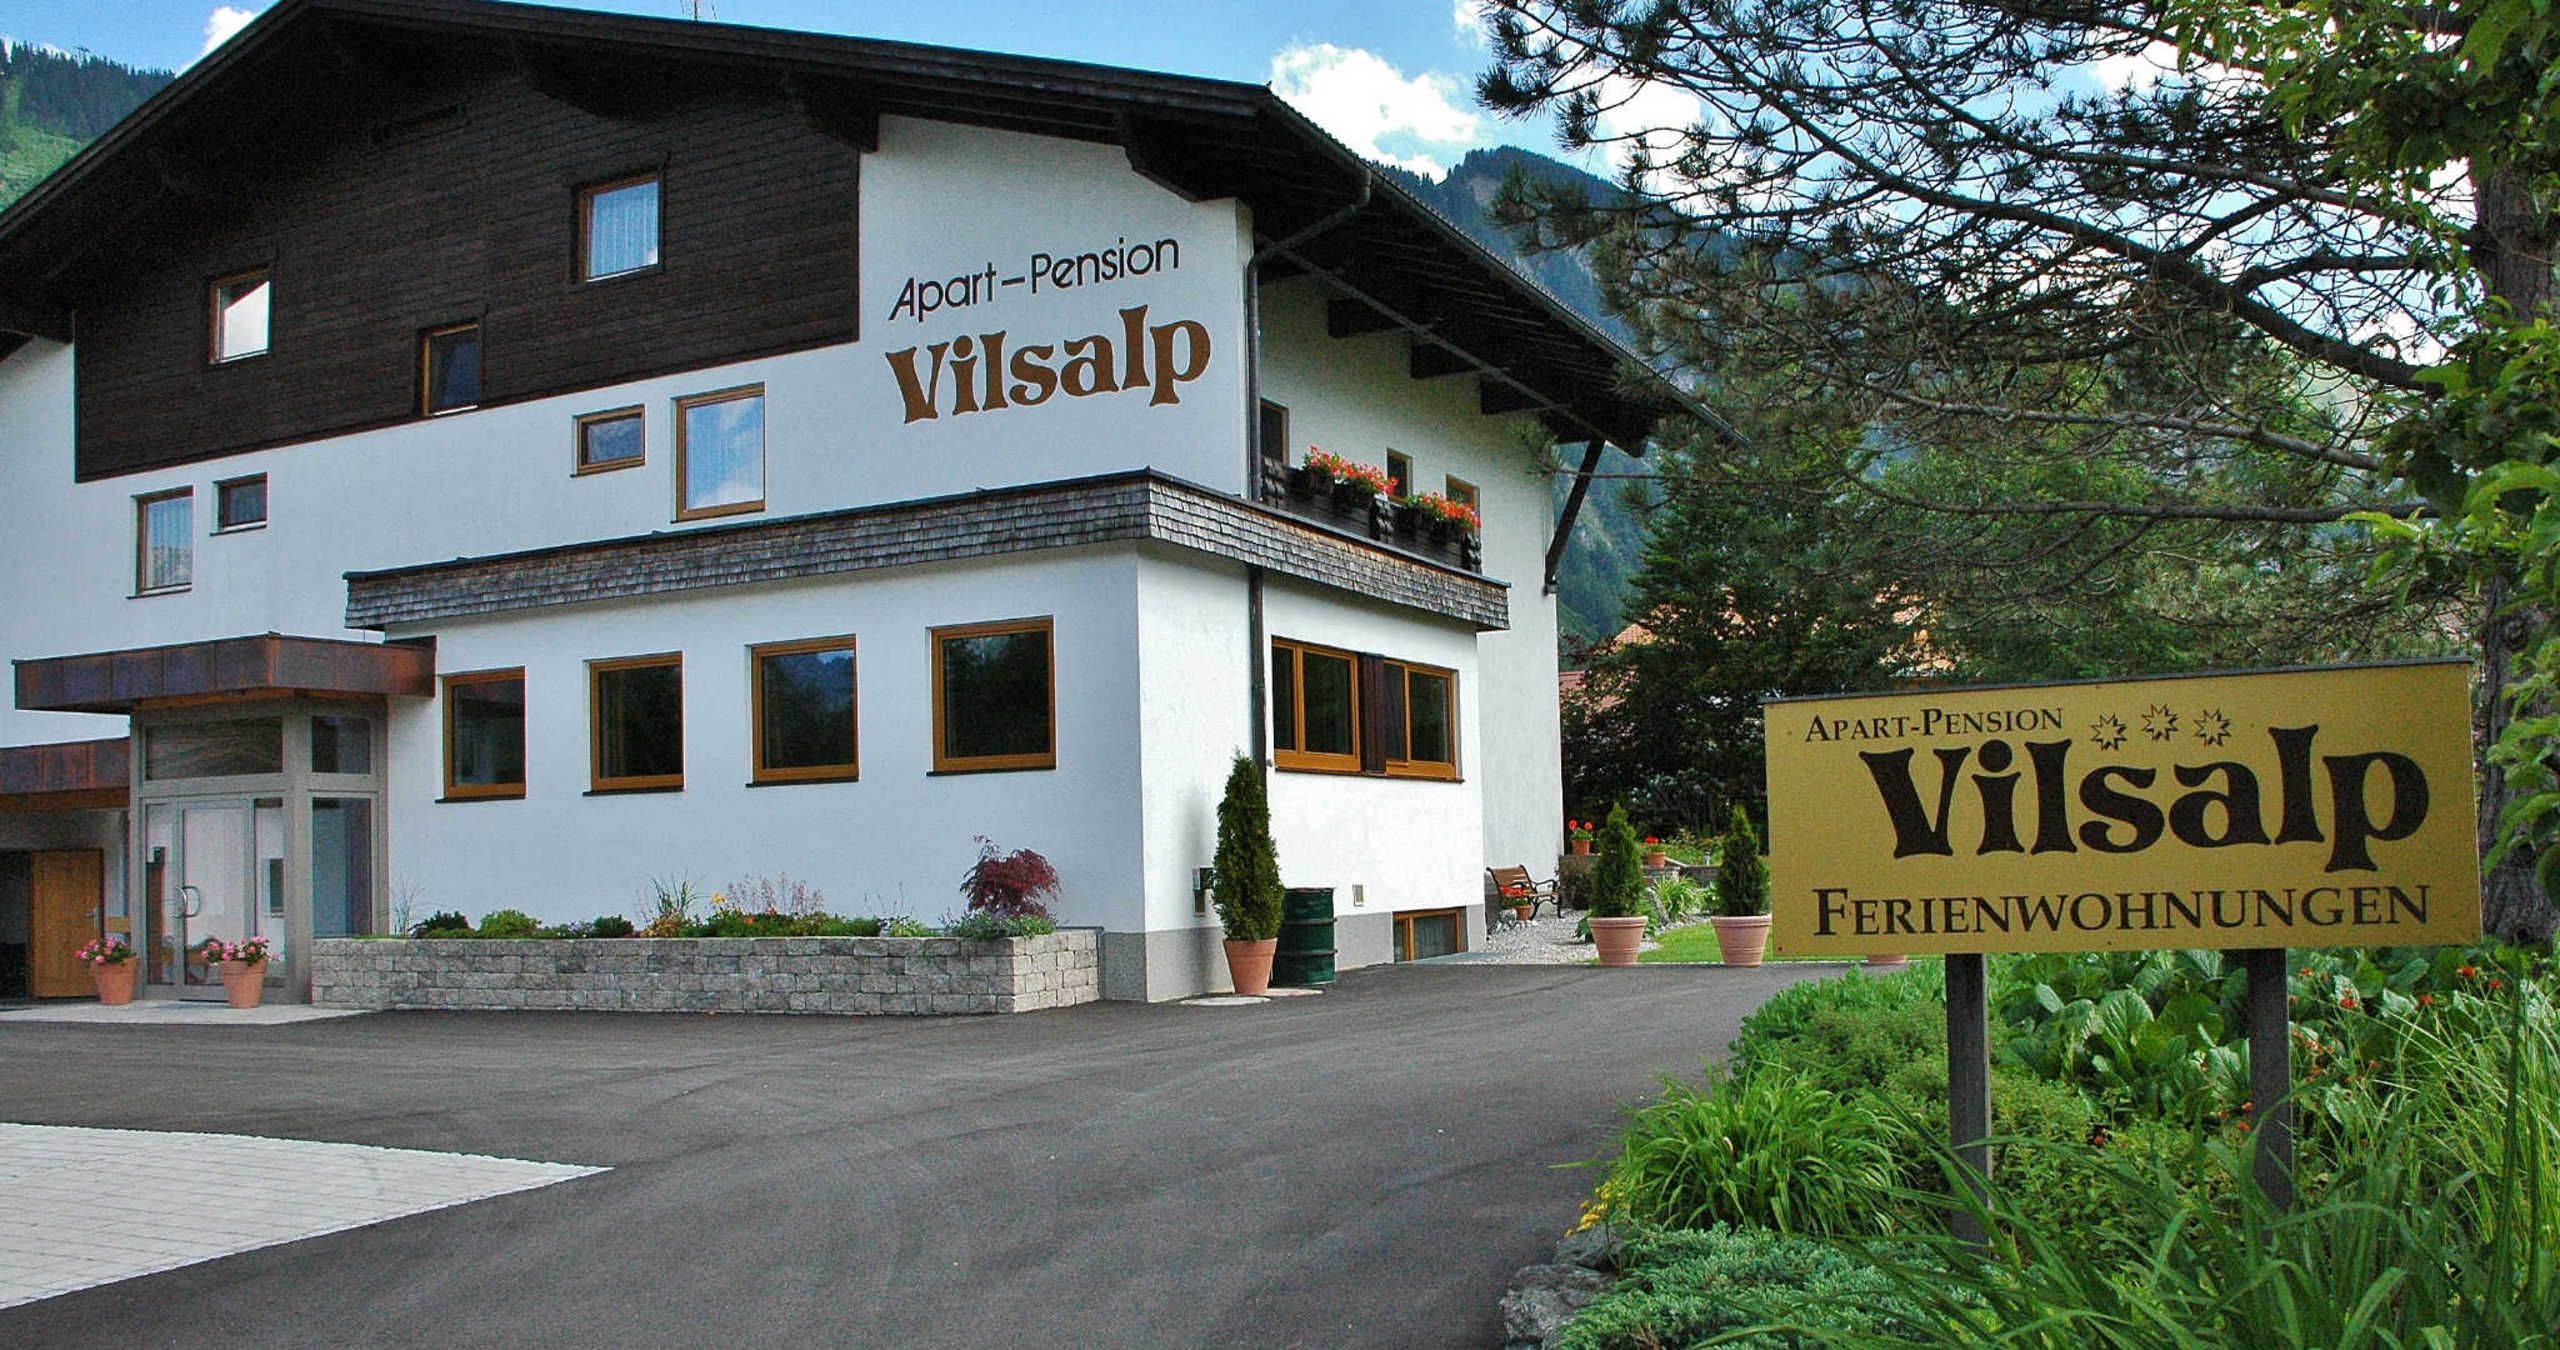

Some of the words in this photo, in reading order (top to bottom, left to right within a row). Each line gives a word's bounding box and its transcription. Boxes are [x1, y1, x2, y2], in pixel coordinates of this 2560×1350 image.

[884, 304, 1211, 424] Vilsalp
[1804, 706, 2064, 743] APART-PENSION
[1858, 723, 2430, 873] Vilsalp
[1812, 884, 2431, 937] FERIENWOHNUNGEN
